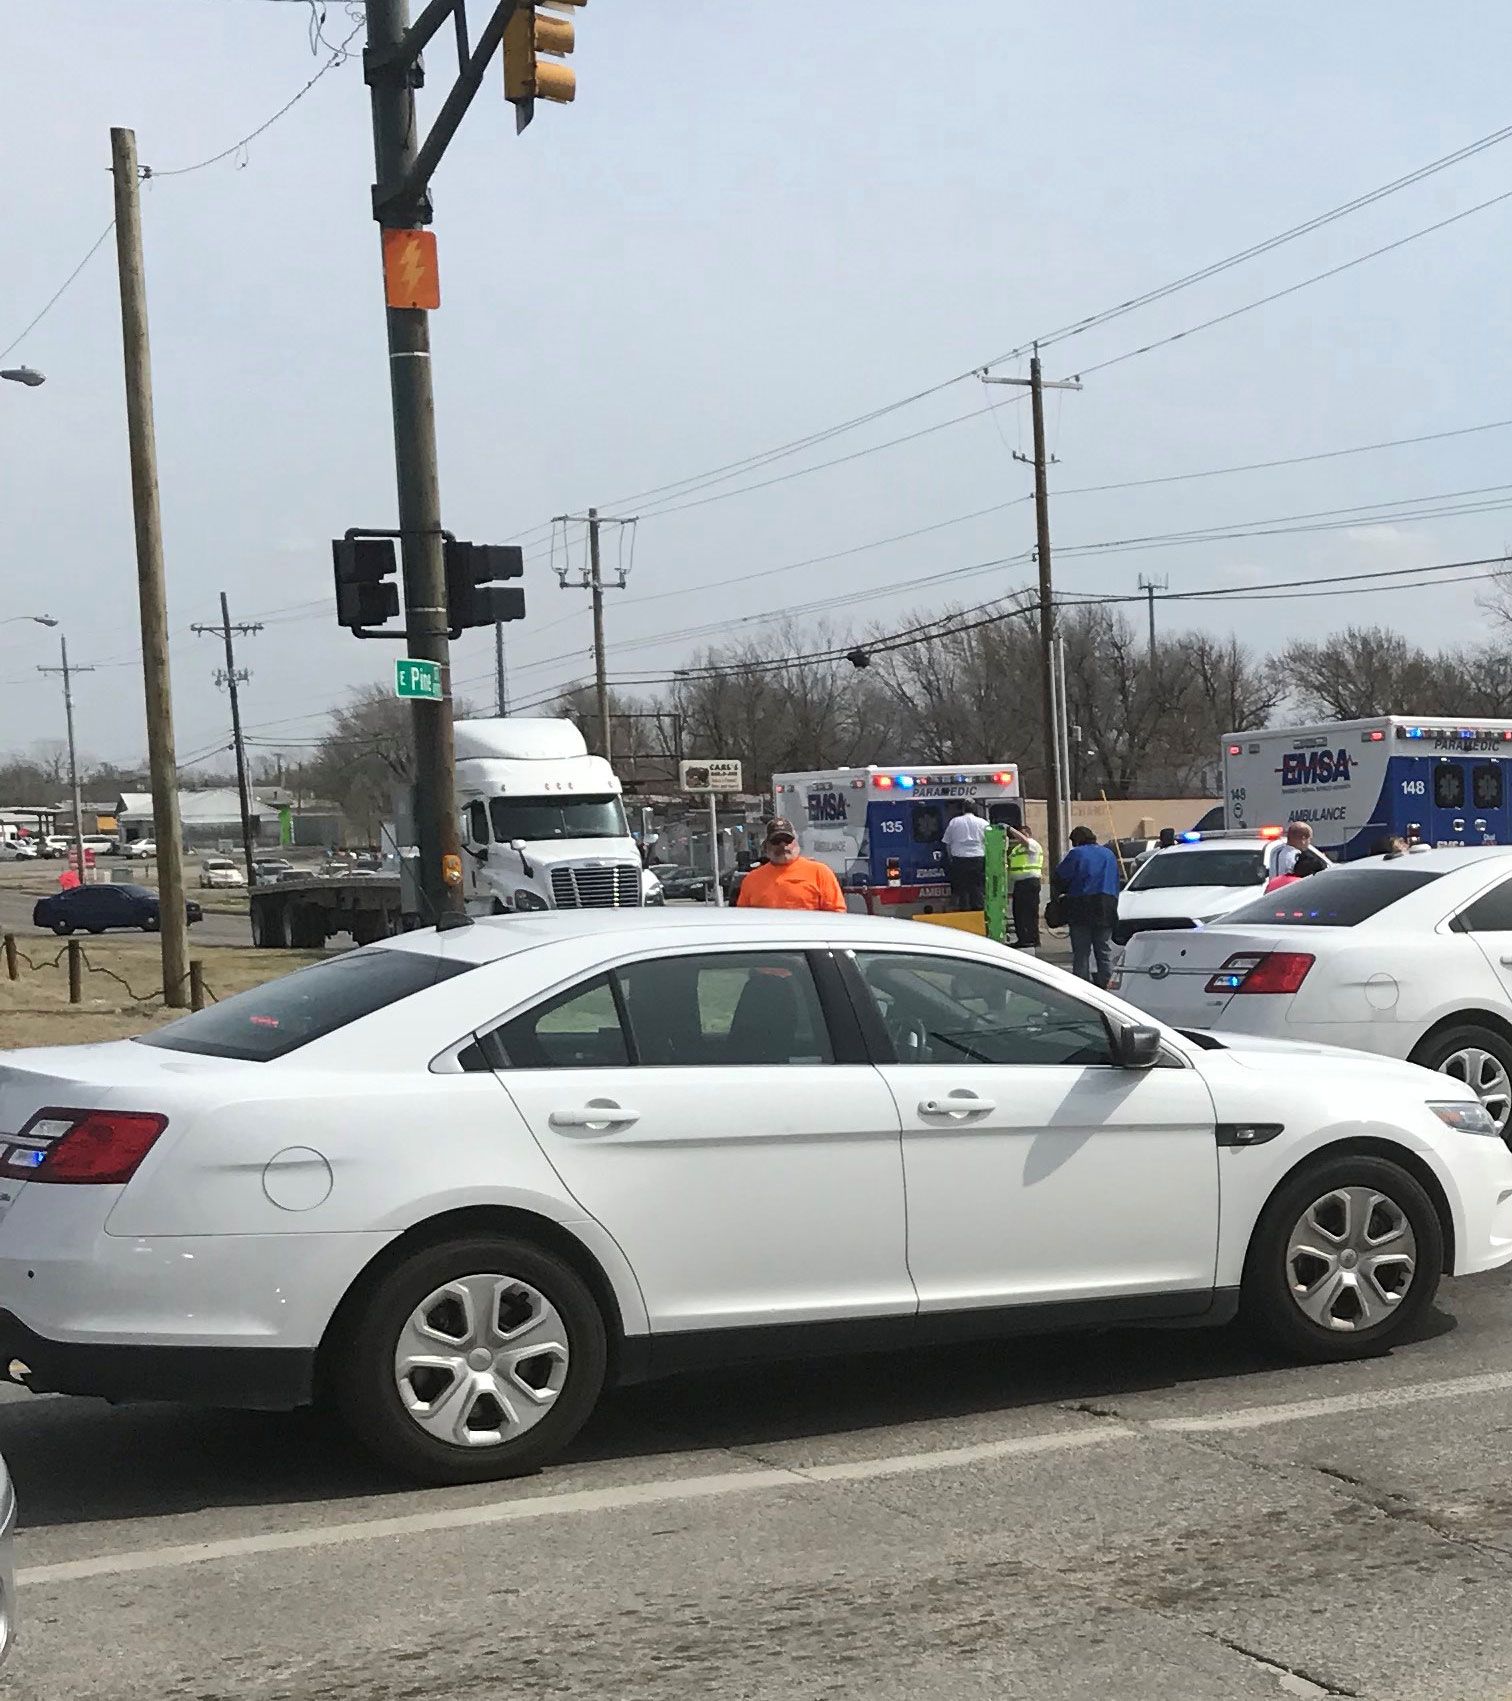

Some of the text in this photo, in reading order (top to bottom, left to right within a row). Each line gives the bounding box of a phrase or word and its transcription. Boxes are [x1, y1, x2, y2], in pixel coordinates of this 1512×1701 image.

[400, 671, 406, 686] E
[411, 666, 431, 692] Pine
[1434, 740, 1500, 752] PARAMEDIC
[1282, 749, 1351, 786] EMSA
[912, 786, 978, 797] PARAMEDIC
[1230, 787, 1246, 801] 148
[1401, 780, 1425, 795] 148
[807, 792, 848, 821] EMSA
[1287, 806, 1347, 823] AMBULANCE
[880, 820, 904, 833] 135
